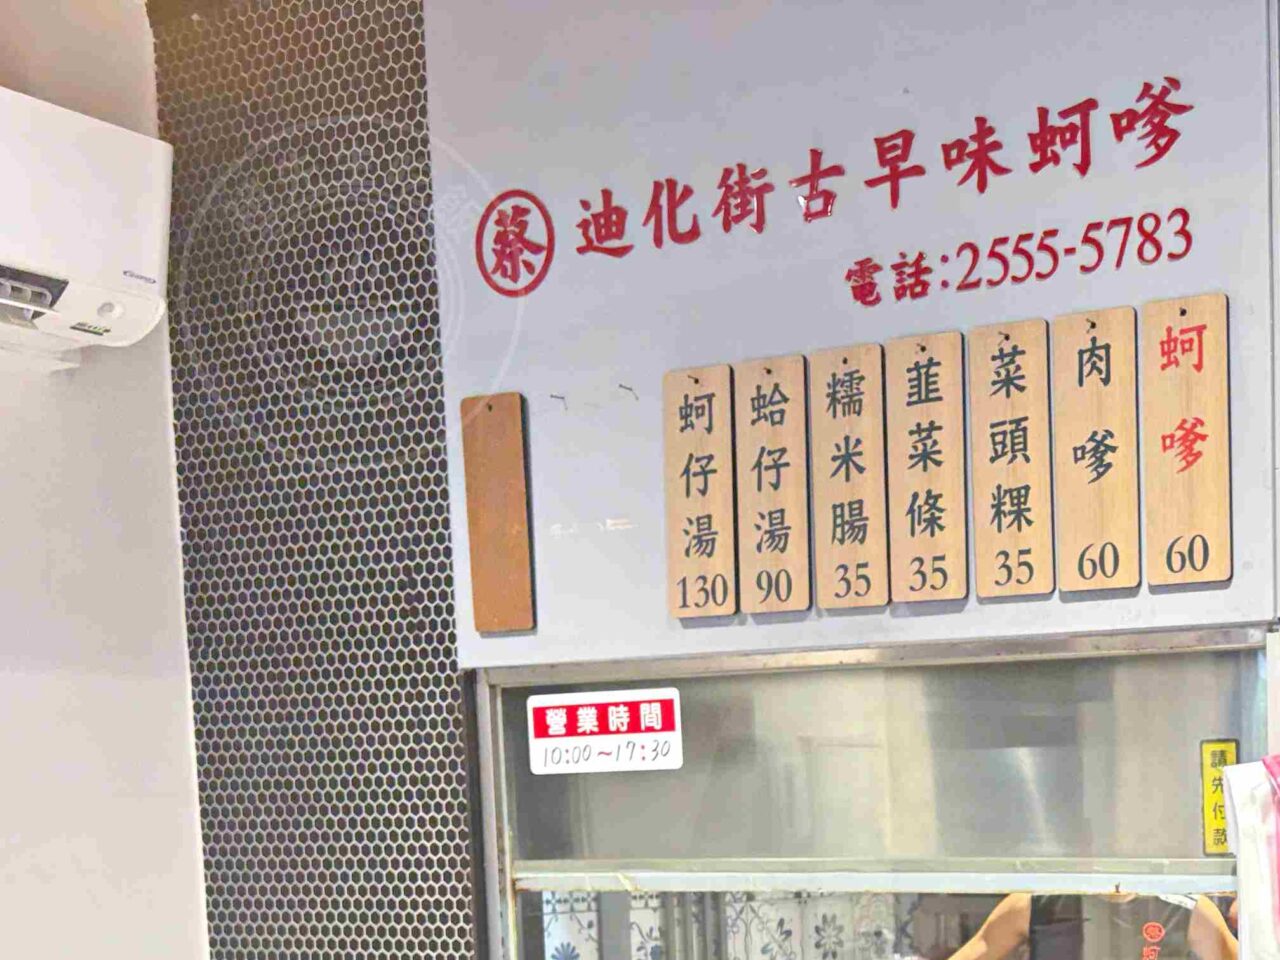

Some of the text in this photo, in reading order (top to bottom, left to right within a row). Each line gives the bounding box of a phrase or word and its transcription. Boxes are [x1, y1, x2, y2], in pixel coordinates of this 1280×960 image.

[489, 75, 1195, 286] 蔡 迪化街古早味蚵嗲
[1071, 335, 1120, 485] 肉嗲
[1158, 323, 1210, 475] 蚵嗲
[825, 368, 870, 547] 糯米腸
[989, 344, 1035, 534] 菜頭粿
[678, 391, 720, 559] 蚵仔湯
[750, 382, 792, 555] 蛤仔湯
[908, 553, 949, 593] 35
[993, 547, 1035, 587] 35
[1076, 541, 1121, 581] 60
[1165, 533, 1210, 574] 60
[676, 572, 729, 610] 130
[755, 568, 793, 605] 90
[833, 561, 872, 599] 35
[544, 702, 663, 736] 營業時間
